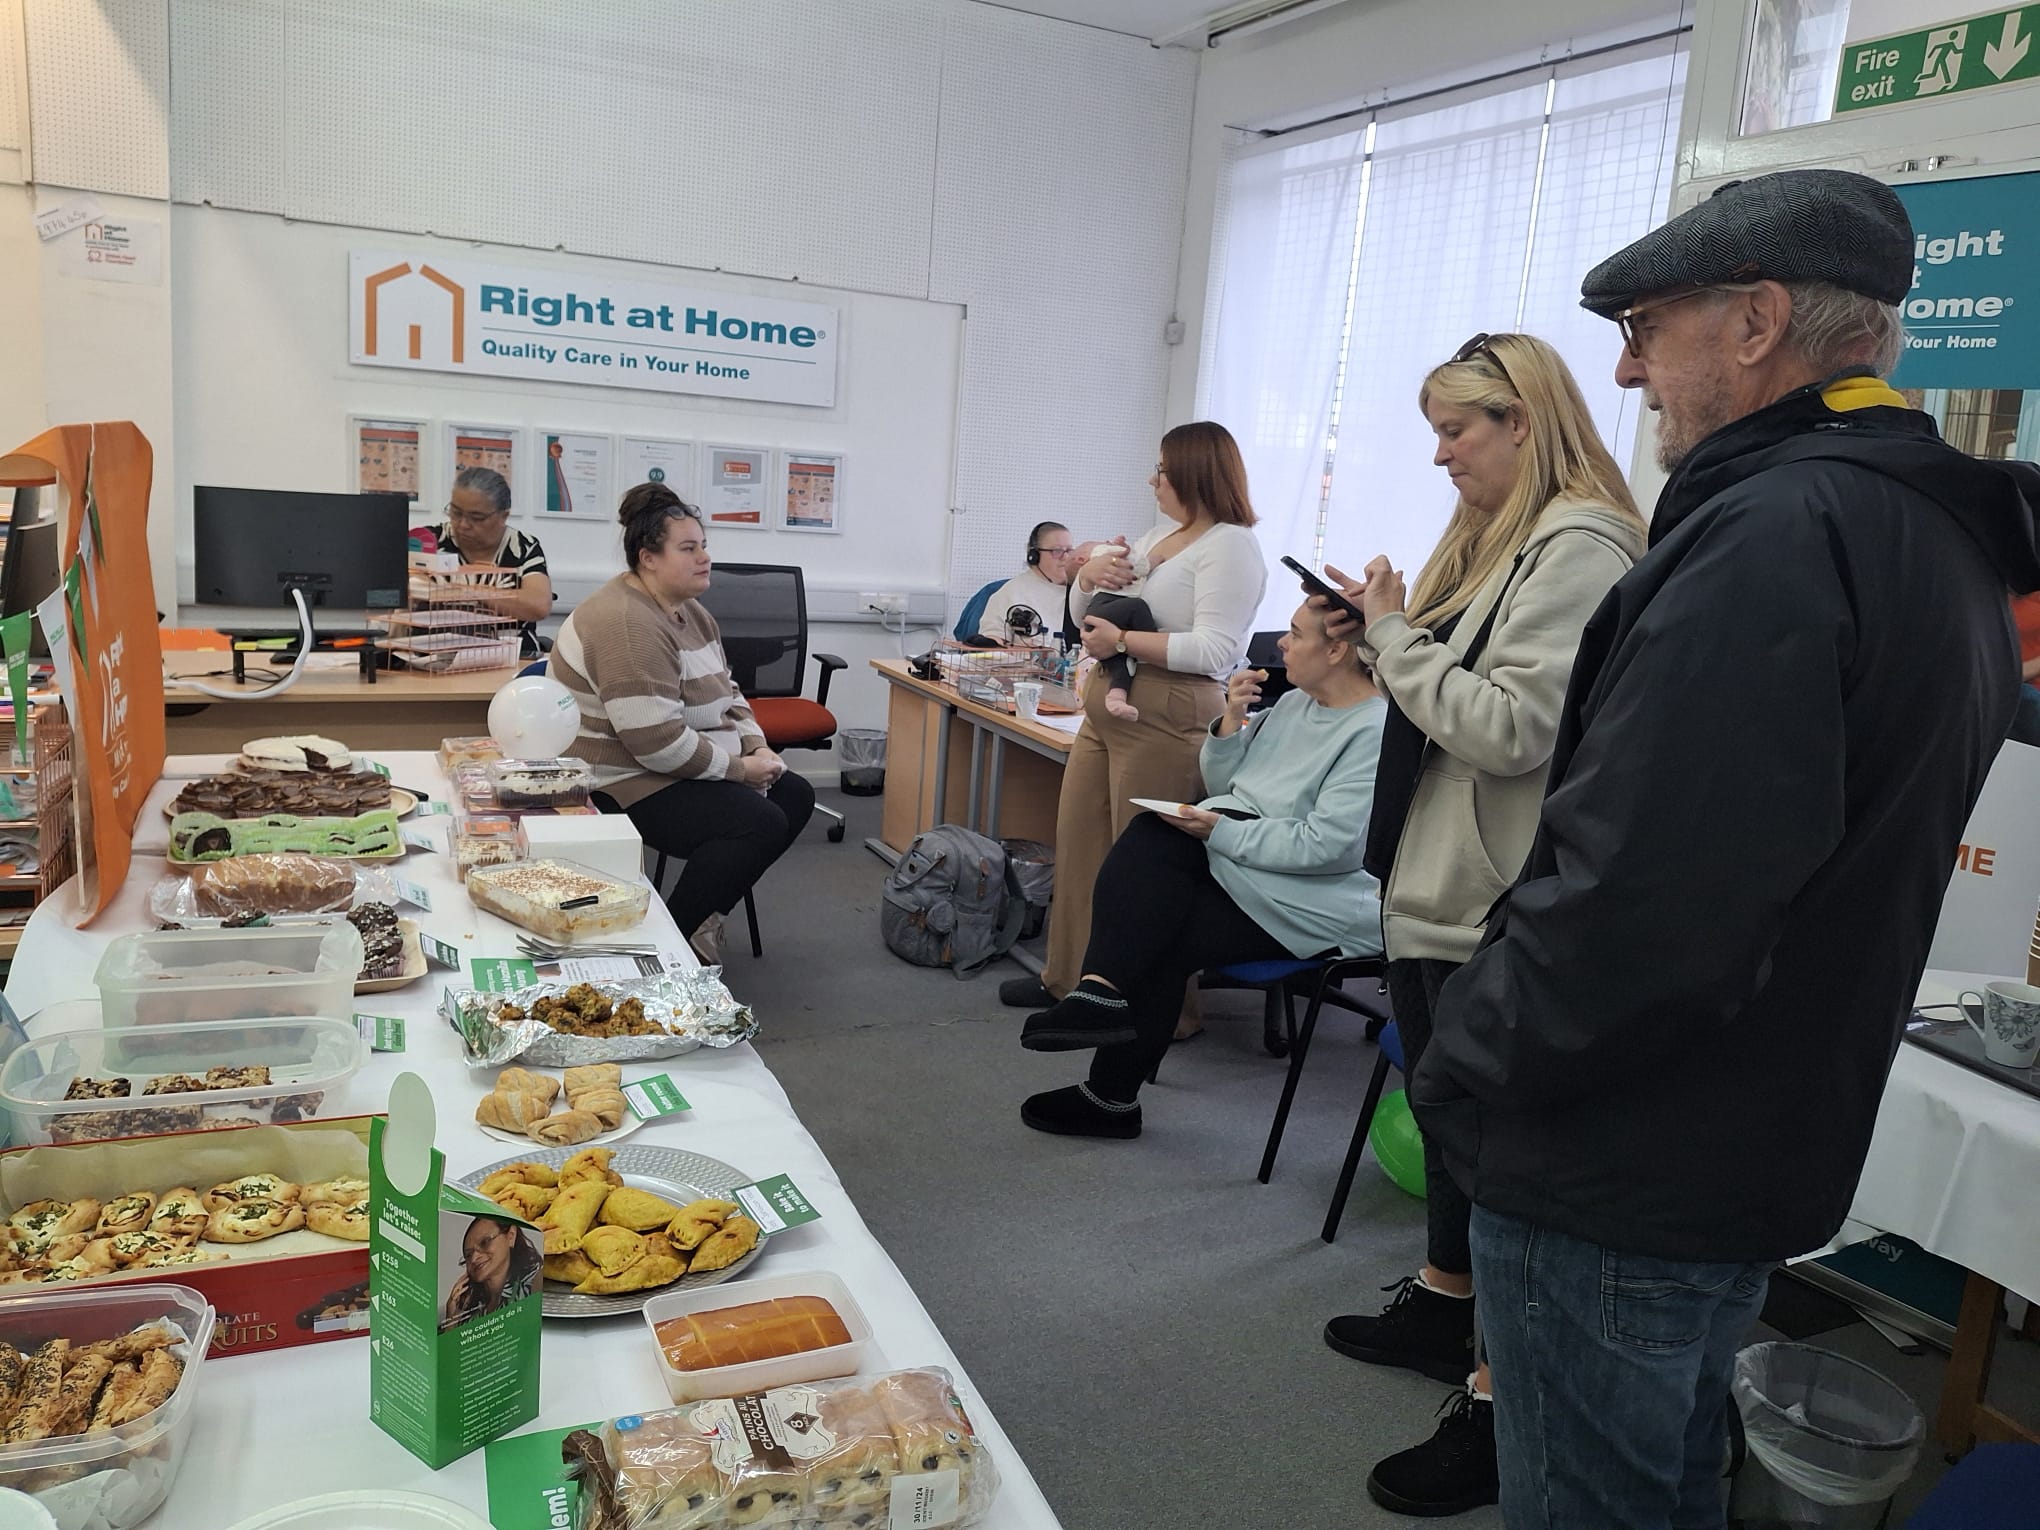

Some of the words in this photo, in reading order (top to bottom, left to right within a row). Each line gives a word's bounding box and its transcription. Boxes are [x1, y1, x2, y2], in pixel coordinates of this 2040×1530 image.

[1855, 49, 1900, 74] Fire
[1851, 76, 1895, 102] exit
[1914, 230, 2004, 264] ight
[1911, 265, 1922, 289] t
[480, 284, 615, 326] Right
[626, 305, 674, 332] at
[1905, 335, 1942, 349] Your
[1947, 335, 1997, 348] Home
[481, 339, 557, 364] Quality
[565, 347, 612, 366] Care
[620, 353, 638, 368] in
[645, 355, 689, 374] Your
[696, 361, 750, 380] Home
[773, 1191, 784, 1199] it
[781, 1183, 791, 1191] it
[786, 1189, 803, 1206] make
[383, 1207, 399, 1226] let's
[384, 1198, 419, 1226] Together
[778, 1197, 795, 1213] Bake
[799, 1205, 810, 1213] to
[460, 1329, 473, 1338] We
[505, 1309, 516, 1318] do
[516, 1305, 522, 1313] it
[460, 1329, 490, 1346] without
[491, 1323, 505, 1335] you
[736, 1400, 748, 1412] AU
[742, 1413, 759, 1441] PAINS
[745, 1395, 775, 1451] CHOCOLAT
[790, 1420, 804, 1429] 8
[913, 1487, 924, 1524] 30/11/24
